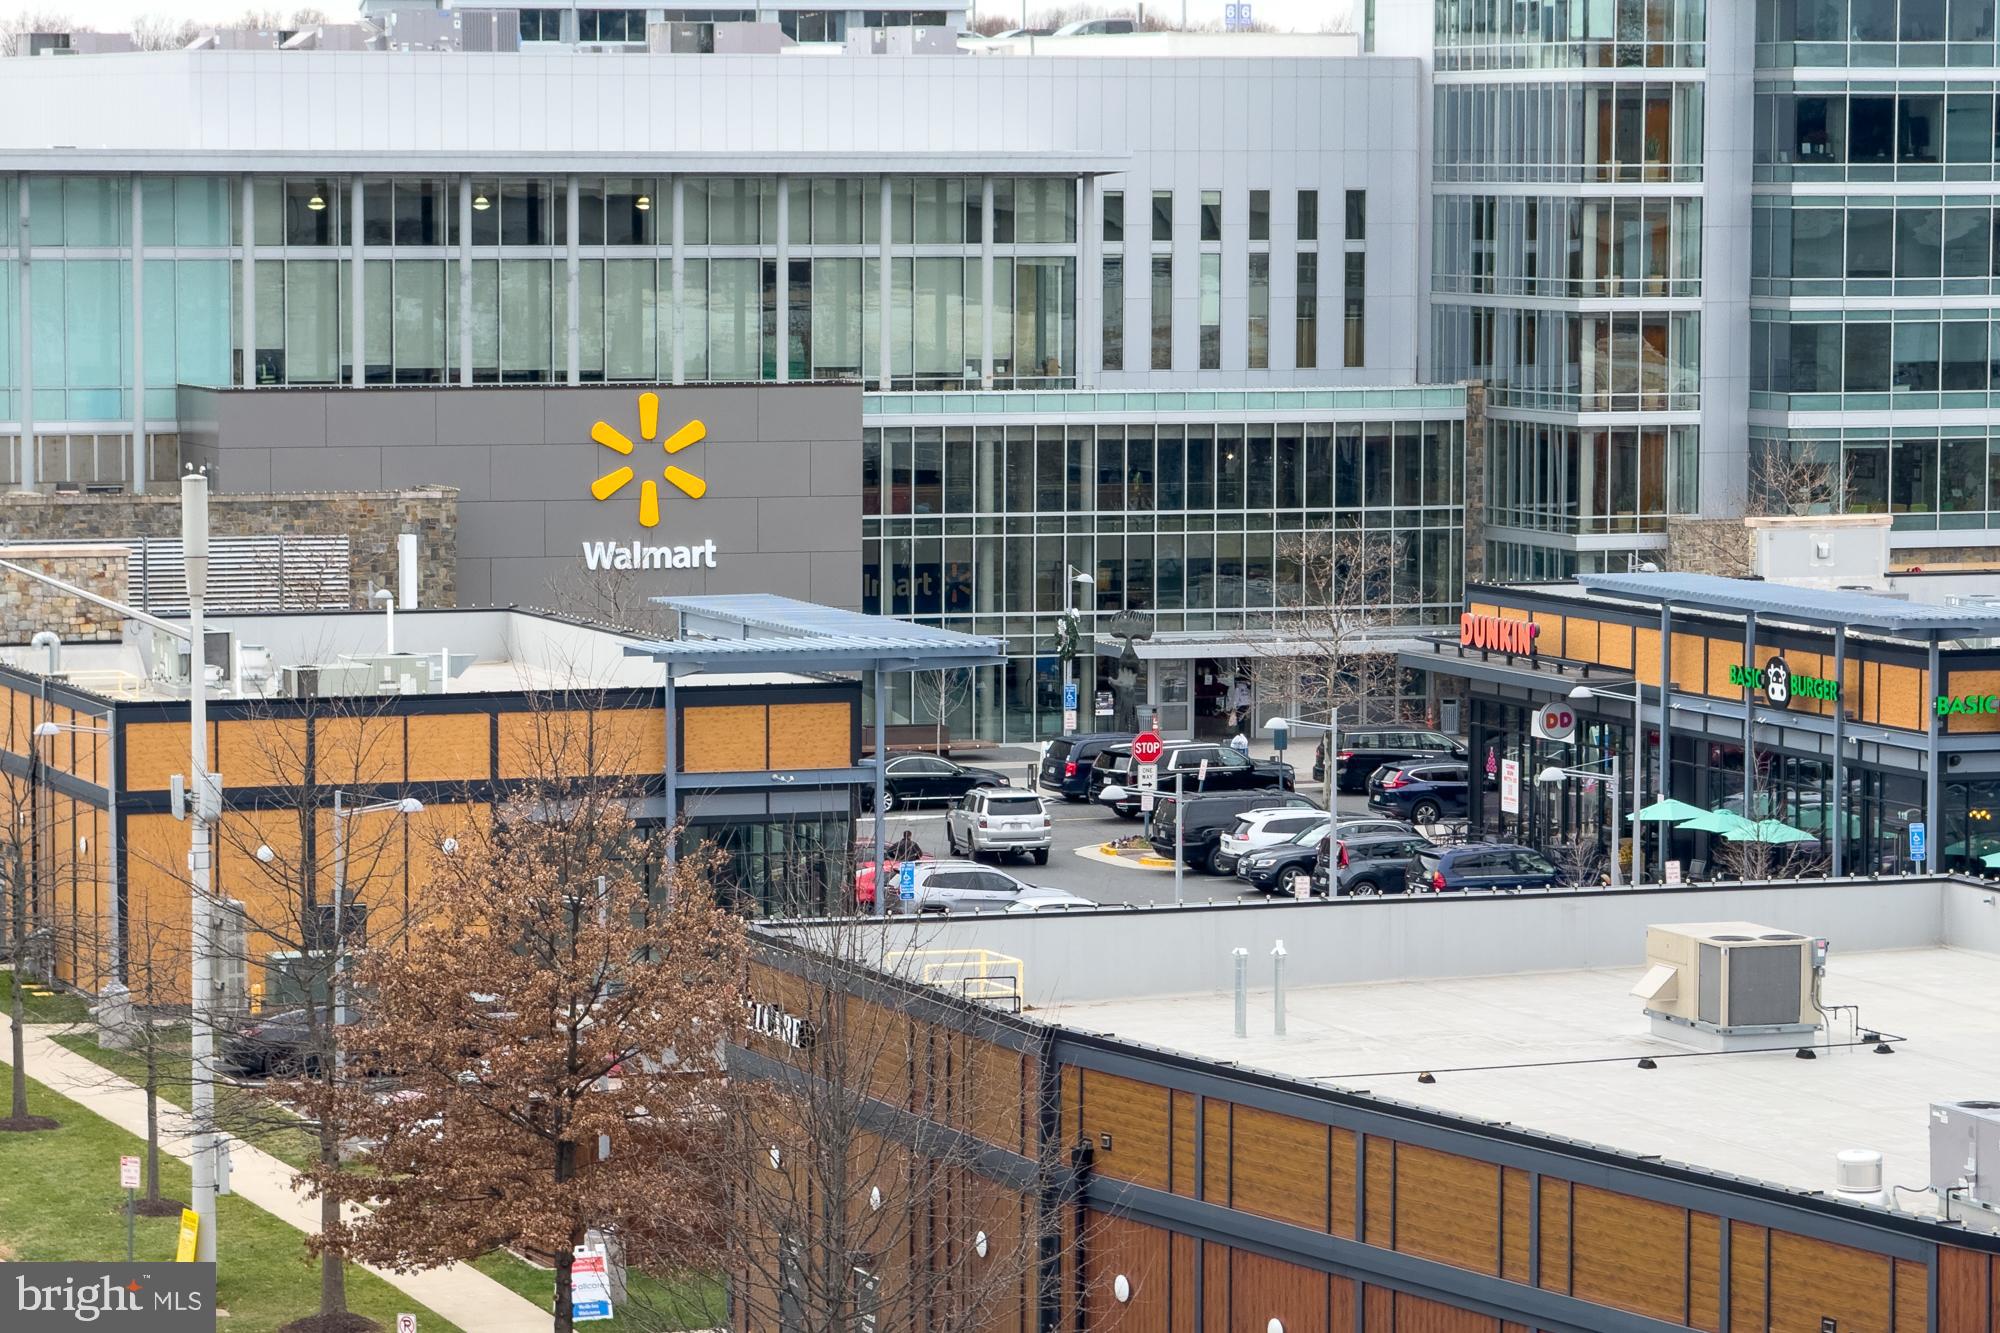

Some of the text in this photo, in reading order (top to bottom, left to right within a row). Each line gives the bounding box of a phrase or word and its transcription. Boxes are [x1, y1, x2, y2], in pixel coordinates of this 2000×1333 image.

[1241, 5, 1250, 18] 6
[582, 539, 717, 570] Walmart
[1729, 664, 1838, 701] BASIC BURGER
[1937, 694, 1998, 715] BASIC
[1135, 741, 1160, 754] STOP
